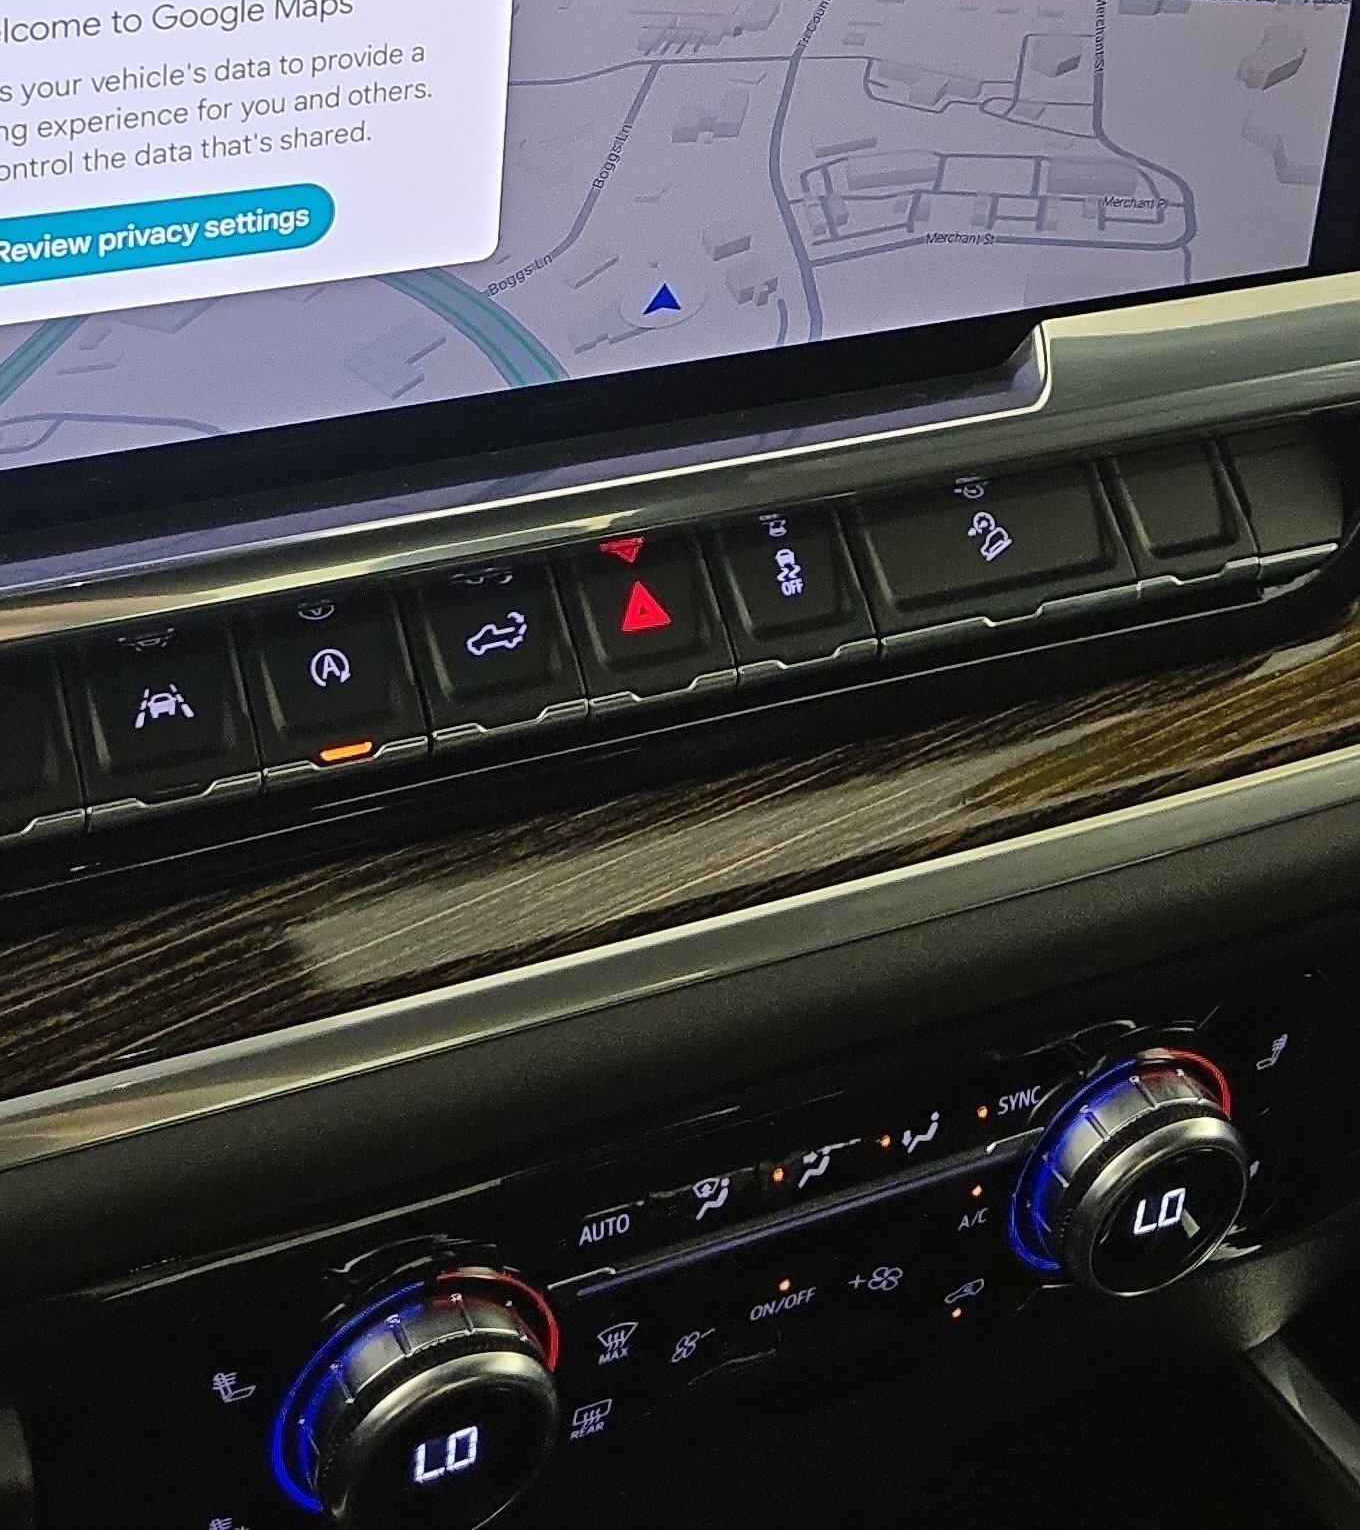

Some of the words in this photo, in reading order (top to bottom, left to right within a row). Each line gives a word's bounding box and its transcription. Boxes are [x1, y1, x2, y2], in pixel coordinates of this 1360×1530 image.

[111, 10, 142, 34] to
[21, 77, 83, 106] your
[90, 62, 207, 93] vehicle's
[214, 57, 271, 81] data
[279, 55, 304, 75] to
[311, 43, 404, 77] provide
[411, 45, 425, 62] a
[37, 105, 188, 140] experience
[197, 97, 233, 121] for
[241, 96, 286, 122] you
[293, 84, 340, 112] and
[348, 80, 433, 106] others.
[83, 148, 126, 172] the
[135, 142, 192, 166] data
[201, 132, 273, 158] that's
[279, 119, 372, 151] shared.
[593, 144, 622, 189] Boggs
[615, 123, 633, 142] Ln
[1102, 195, 1155, 209] Merchant
[98, 222, 200, 258] privacy
[205, 207, 311, 238] settings
[926, 232, 982, 246] Merchant
[488, 267, 533, 296] Boggs
[534, 254, 553, 269] Ln
[781, 577, 804, 596] OFF
[997, 1085, 1041, 1115] SYNC
[578, 1213, 631, 1246] AUTO
[958, 1207, 989, 1231] A/C
[750, 1286, 817, 1321] ON/OFF
[598, 1346, 630, 1365] MAX
[569, 1420, 606, 1441] REAR
